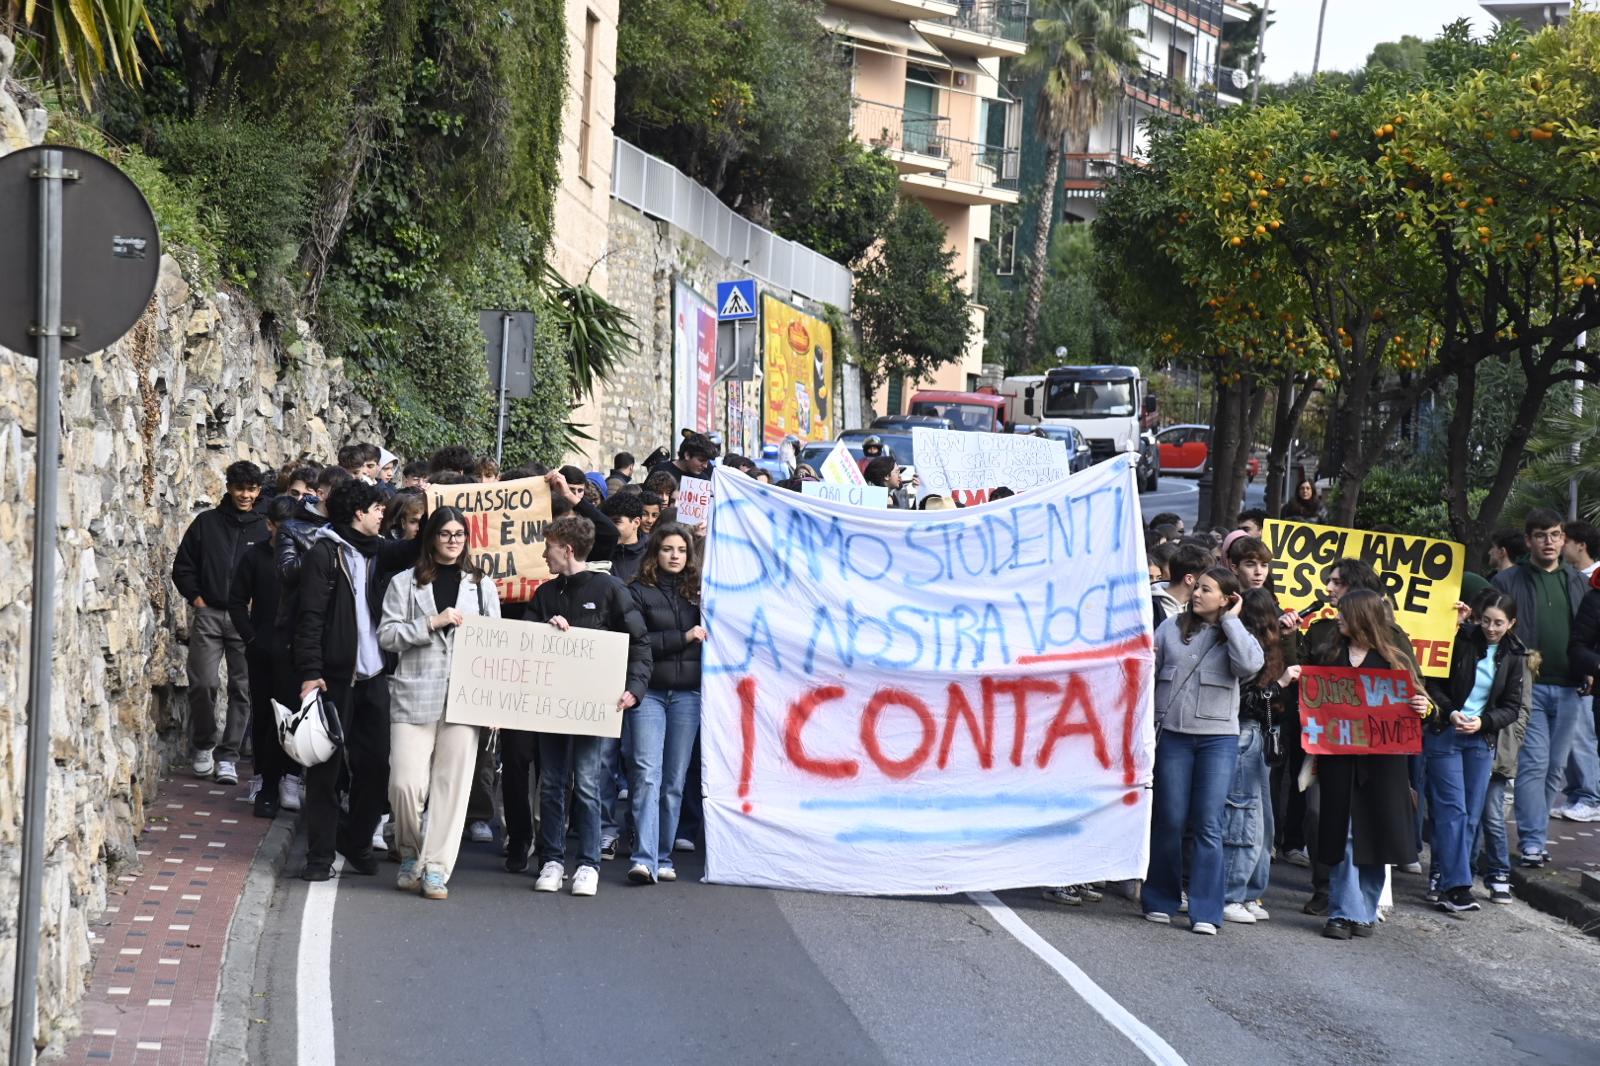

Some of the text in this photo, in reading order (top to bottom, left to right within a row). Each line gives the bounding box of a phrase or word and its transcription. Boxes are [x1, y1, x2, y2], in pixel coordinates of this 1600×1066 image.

[500, 512, 516, 546] È
[904, 486, 1124, 586] STUDENTI
[464, 625, 597, 660] PRIMA DI DECIDERE
[702, 598, 782, 674] LA
[804, 600, 1010, 674] NOSTRA
[471, 655, 555, 687] CHIEDETE
[456, 685, 606, 722] A CHI VIVE LA SCUOLA
[1360, 674, 1409, 708] VALE
[1326, 718, 1369, 747] CHE
